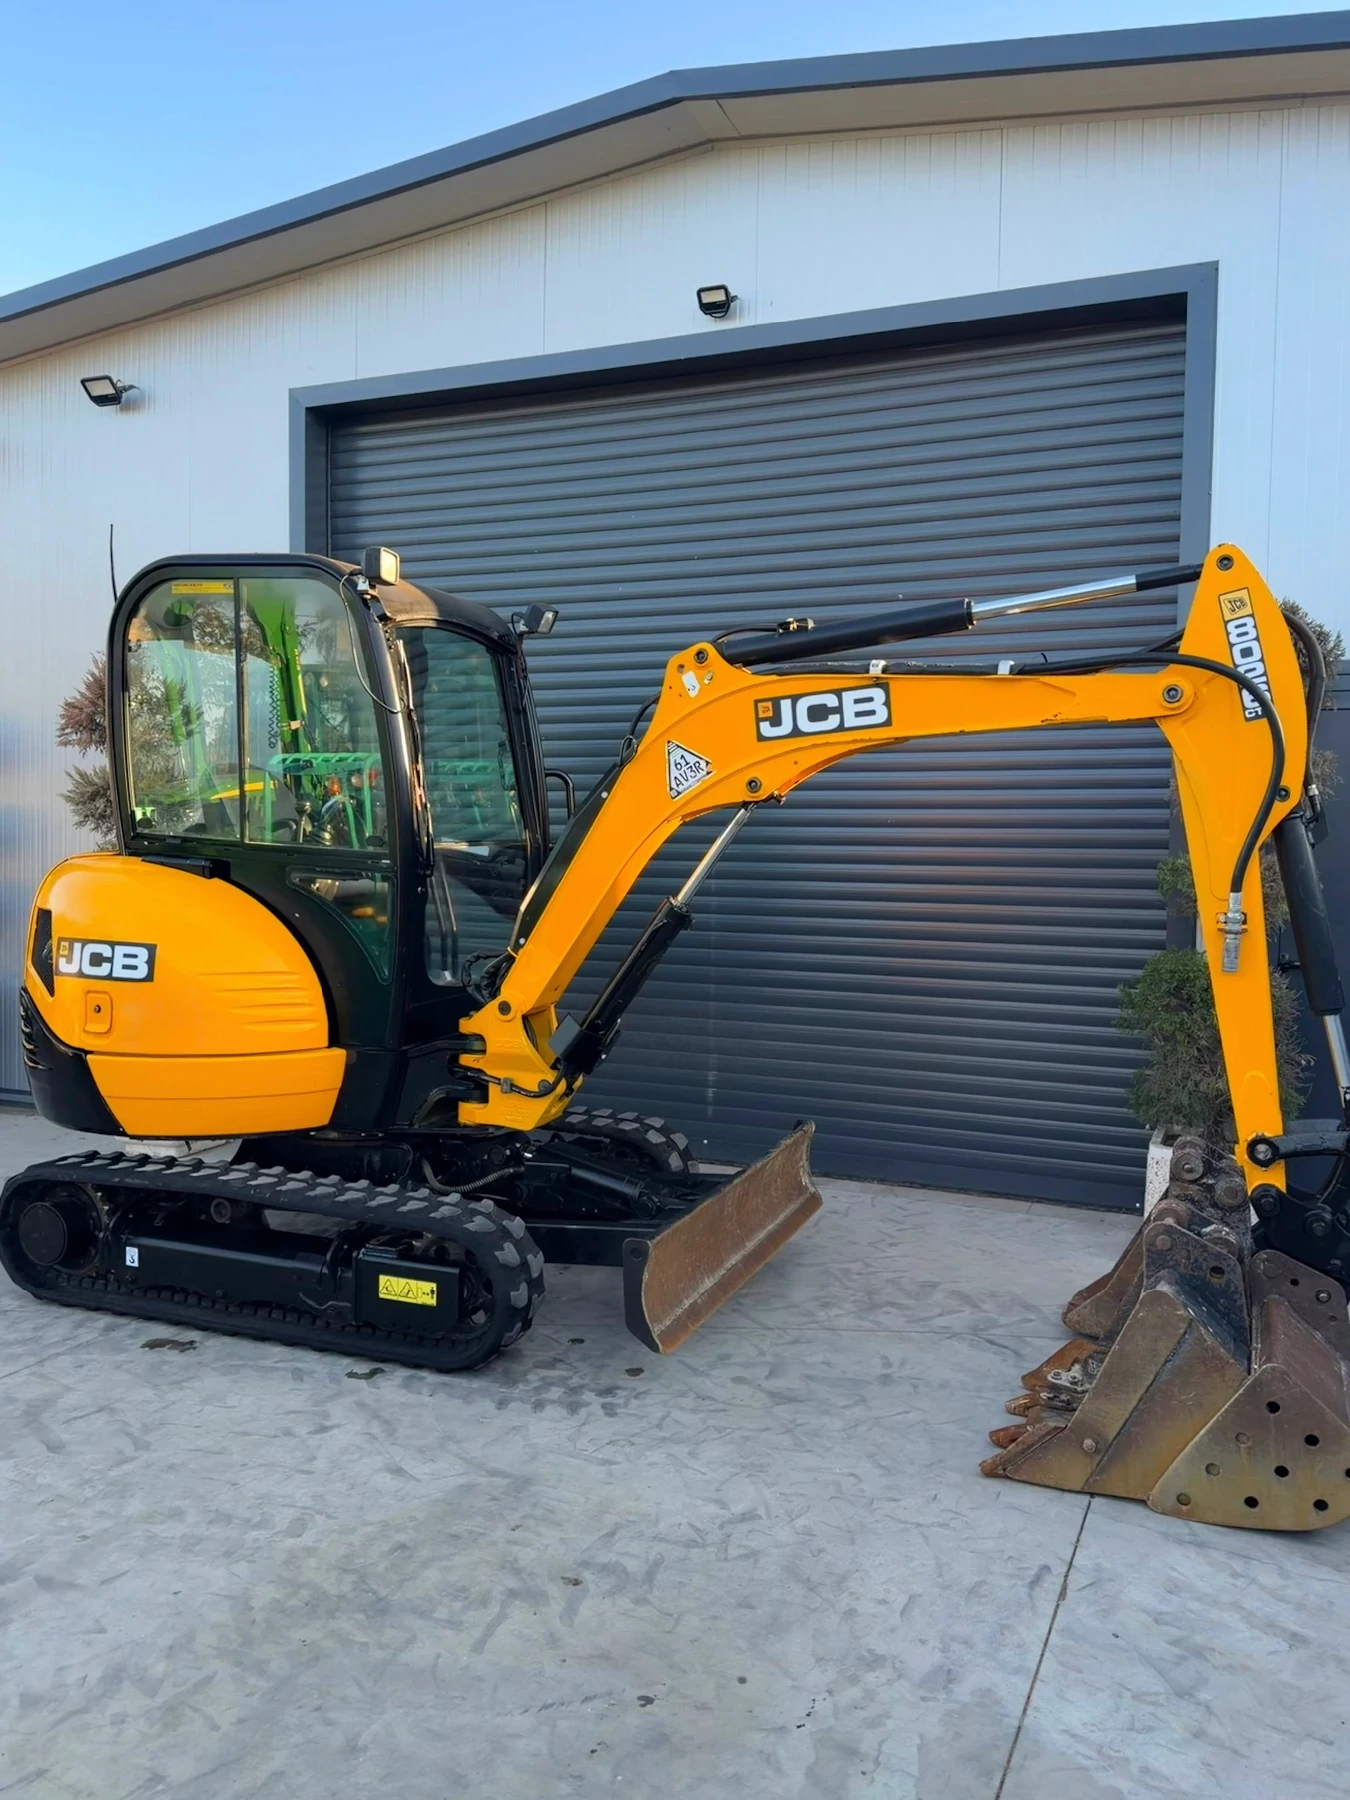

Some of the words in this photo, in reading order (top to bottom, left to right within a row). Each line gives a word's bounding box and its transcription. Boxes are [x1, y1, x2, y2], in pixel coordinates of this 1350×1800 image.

[1228, 597, 1246, 614] JCB
[758, 687, 888, 738] JCB
[673, 760, 705, 788] AV3R
[674, 754, 691, 771] 61
[58, 942, 149, 979] JCB
